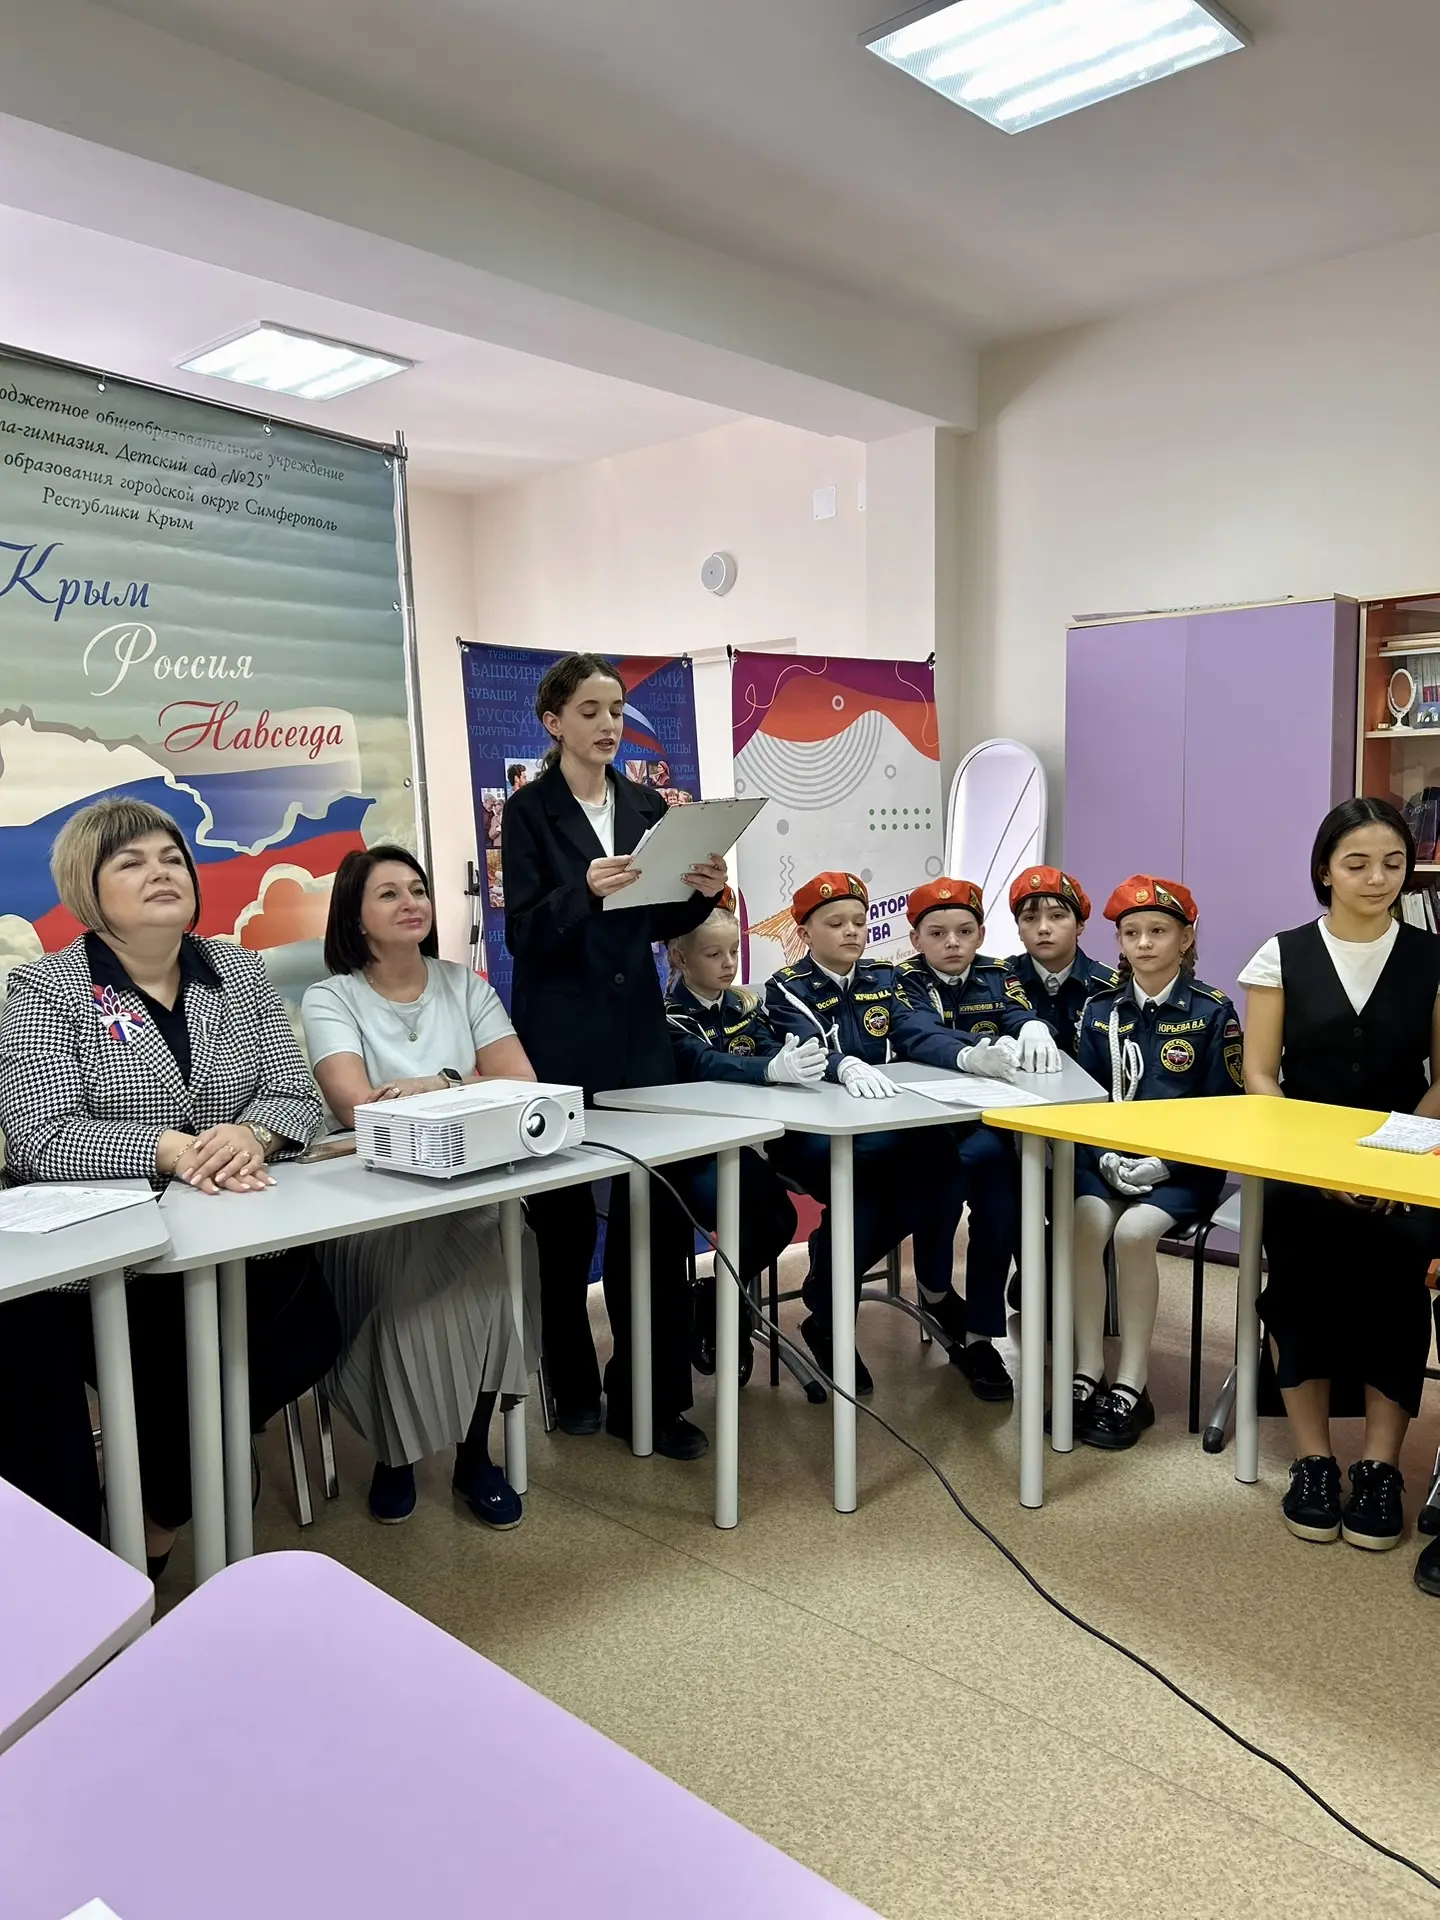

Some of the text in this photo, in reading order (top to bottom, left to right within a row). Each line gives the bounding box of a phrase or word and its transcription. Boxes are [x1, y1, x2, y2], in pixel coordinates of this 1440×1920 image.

[0, 420, 108, 455] ла-гимназия.
[116, 443, 187, 472] Детский
[194, 462, 217, 478] сад
[96, 411, 262, 461] общеобразовательное
[268, 453, 344, 481] учреждение
[4, 453, 338, 531] образования городской округ Симферополь
[42, 486, 194, 530] Республики Крым
[0, 542, 150, 621] Крым
[83, 622, 254, 696] Россия
[471, 662, 546, 680] БАШКИРЫ
[466, 687, 517, 702] ЧУВАШИ
[649, 692, 687, 704] ЛАКЦЫ
[158, 700, 344, 759] Навсегда
[470, 725, 516, 737] УДМУРТЫ
[647, 717, 682, 728] ОРДВА
[816, 997, 839, 1010] ОССИИ
[1158, 1022, 1190, 1033] ЮРЬЕВА
